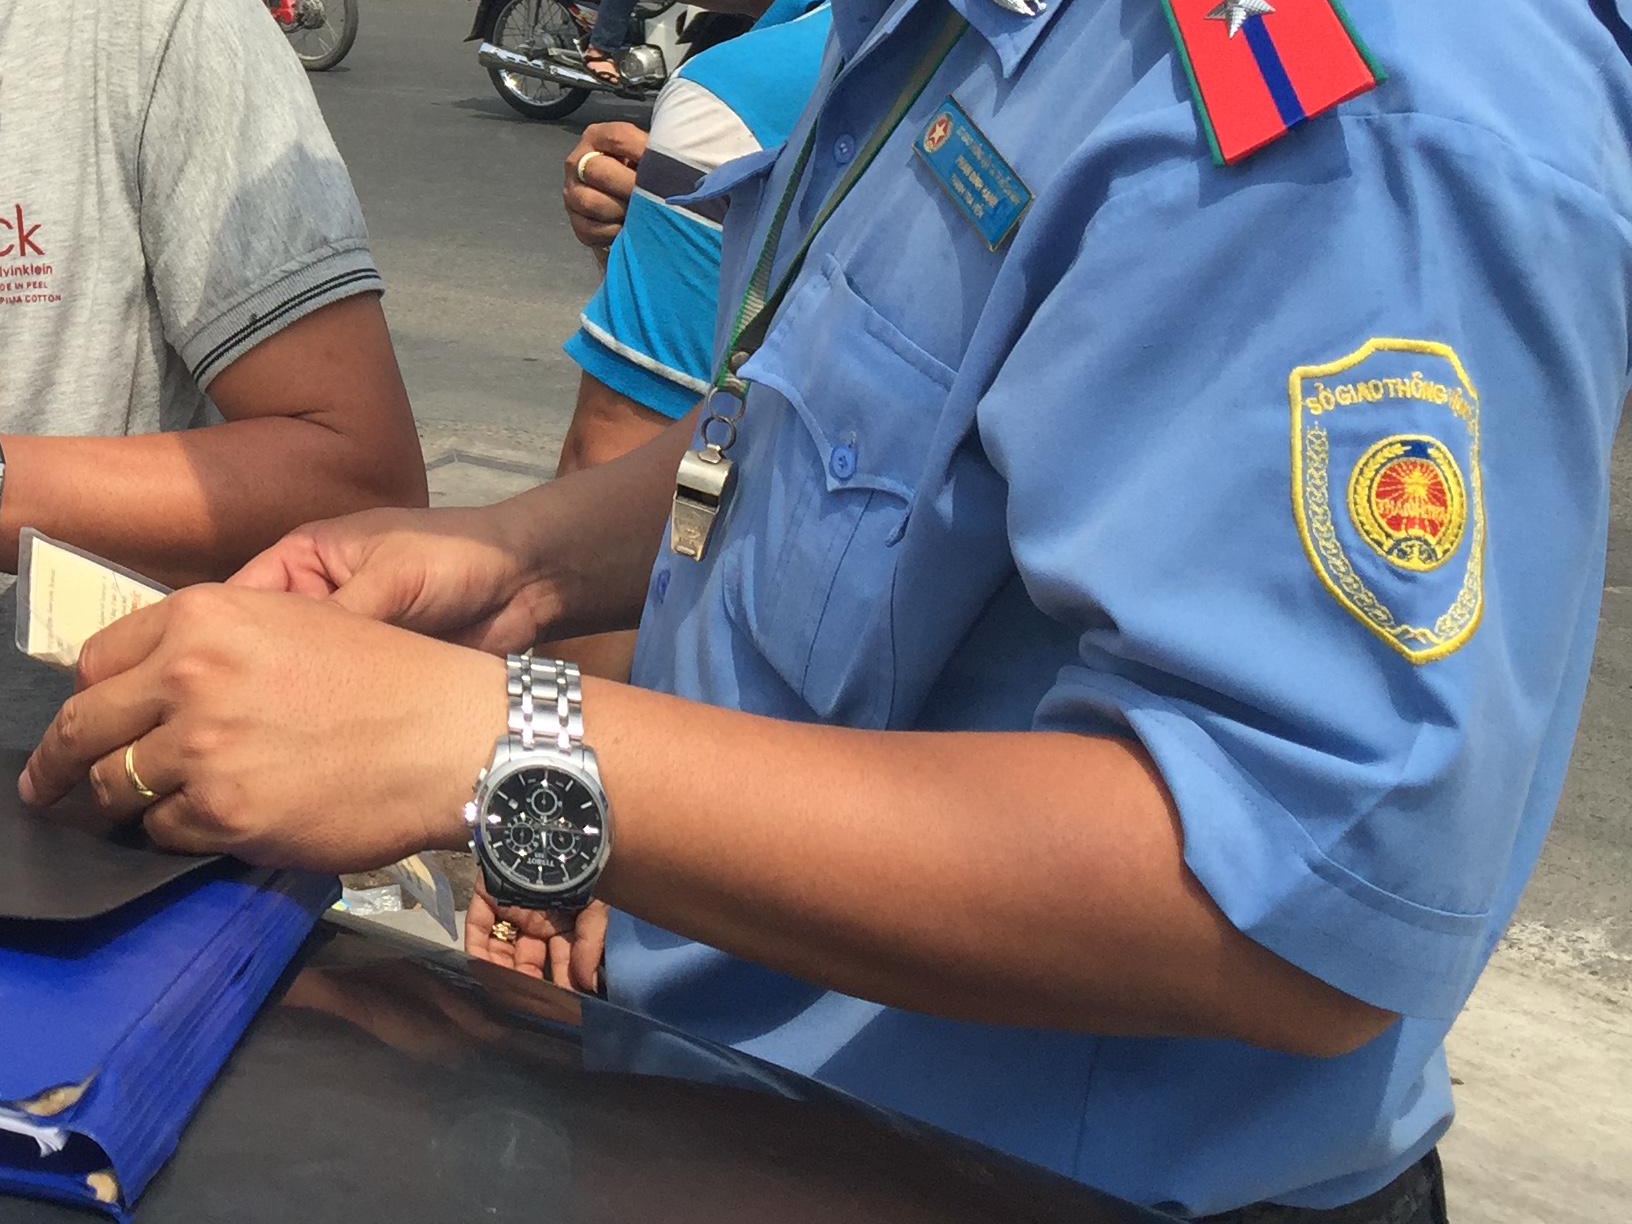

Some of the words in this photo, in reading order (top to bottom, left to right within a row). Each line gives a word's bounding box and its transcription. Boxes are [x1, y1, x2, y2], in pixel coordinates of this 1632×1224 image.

[15, 282, 24, 290] IN
[25, 294, 62, 303] COTTON
[1335, 378, 1385, 406] GIAO
